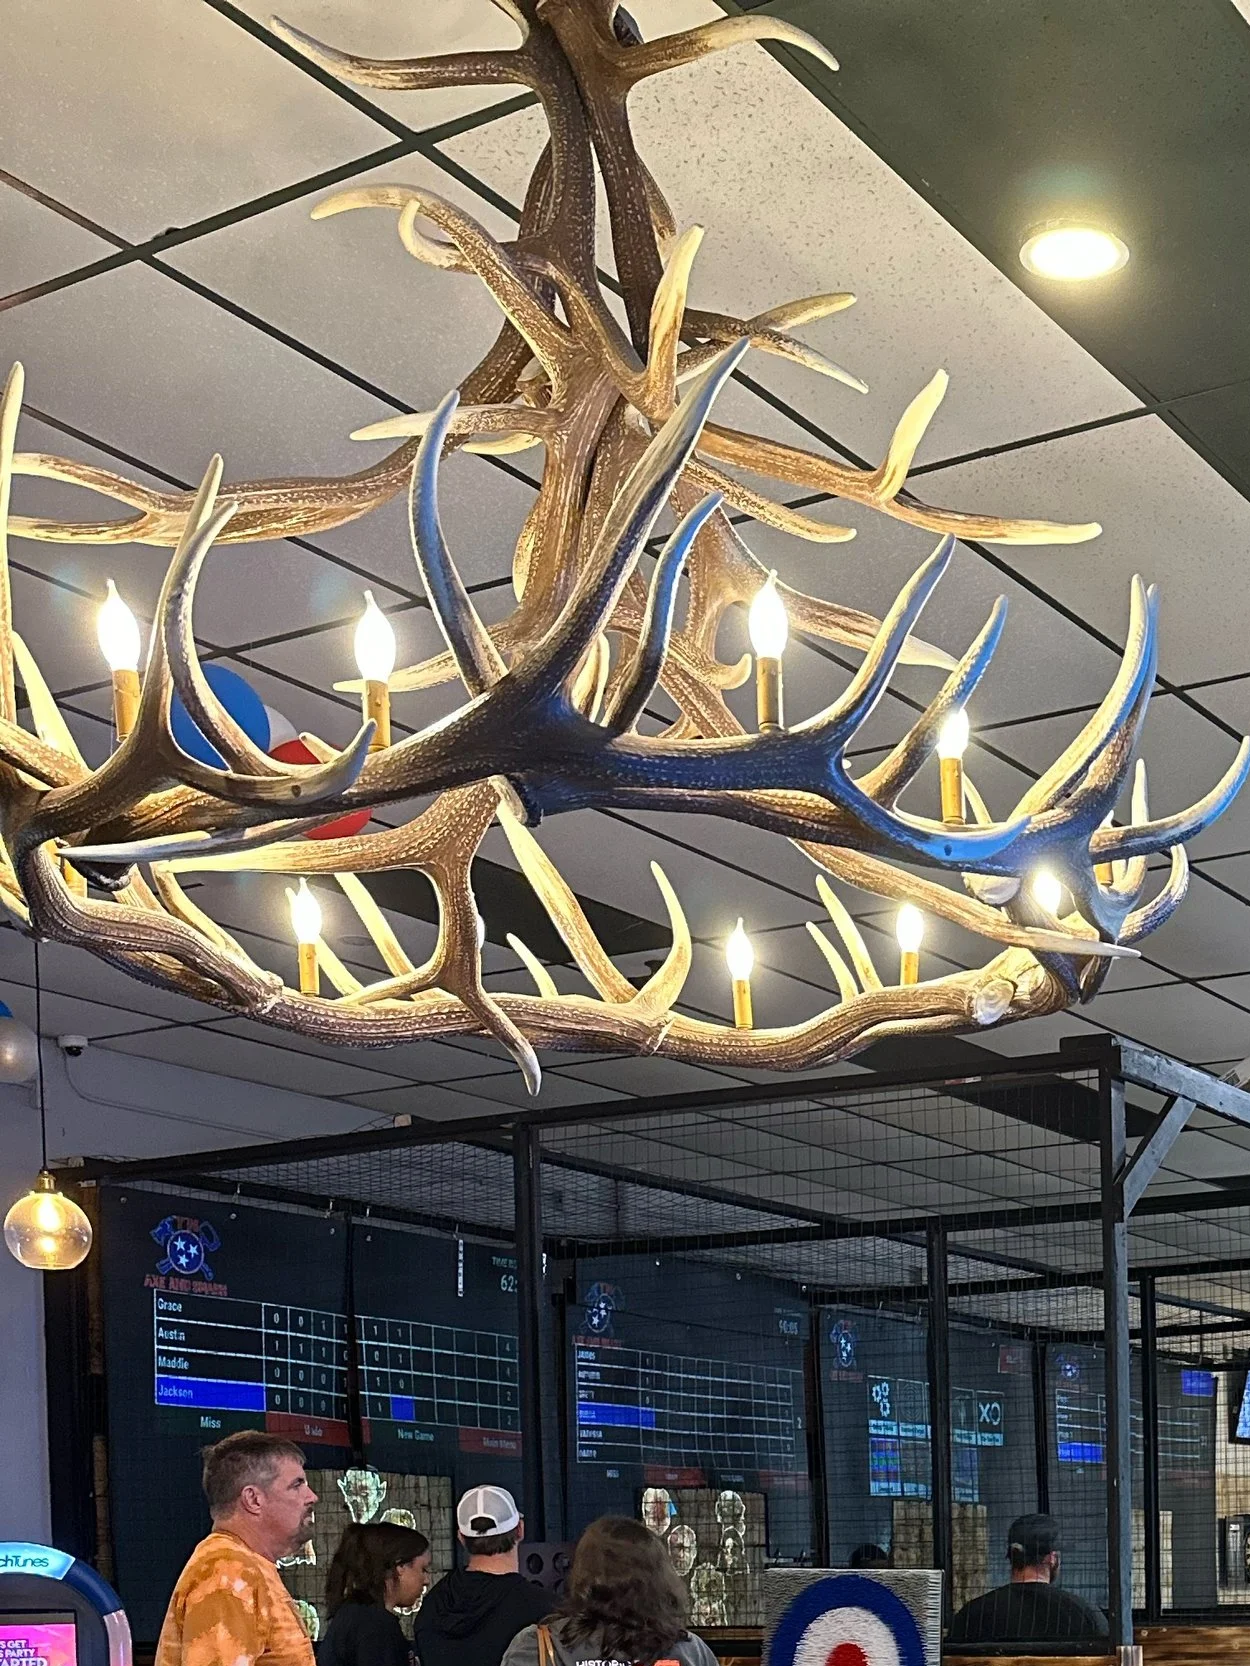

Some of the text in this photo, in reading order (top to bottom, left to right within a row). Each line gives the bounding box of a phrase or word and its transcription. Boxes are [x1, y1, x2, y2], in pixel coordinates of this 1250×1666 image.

[157, 1297, 183, 1313] Grace
[157, 1355, 190, 1371] Maddie
[157, 1384, 194, 1400] Jackson
[200, 1416, 221, 1429] Miss
[414, 1429, 435, 1441] Game
[0, 1555, 49, 1567] chTunes
[7, 1640, 27, 1649] GET
[5, 1648, 35, 1658] PARTY
